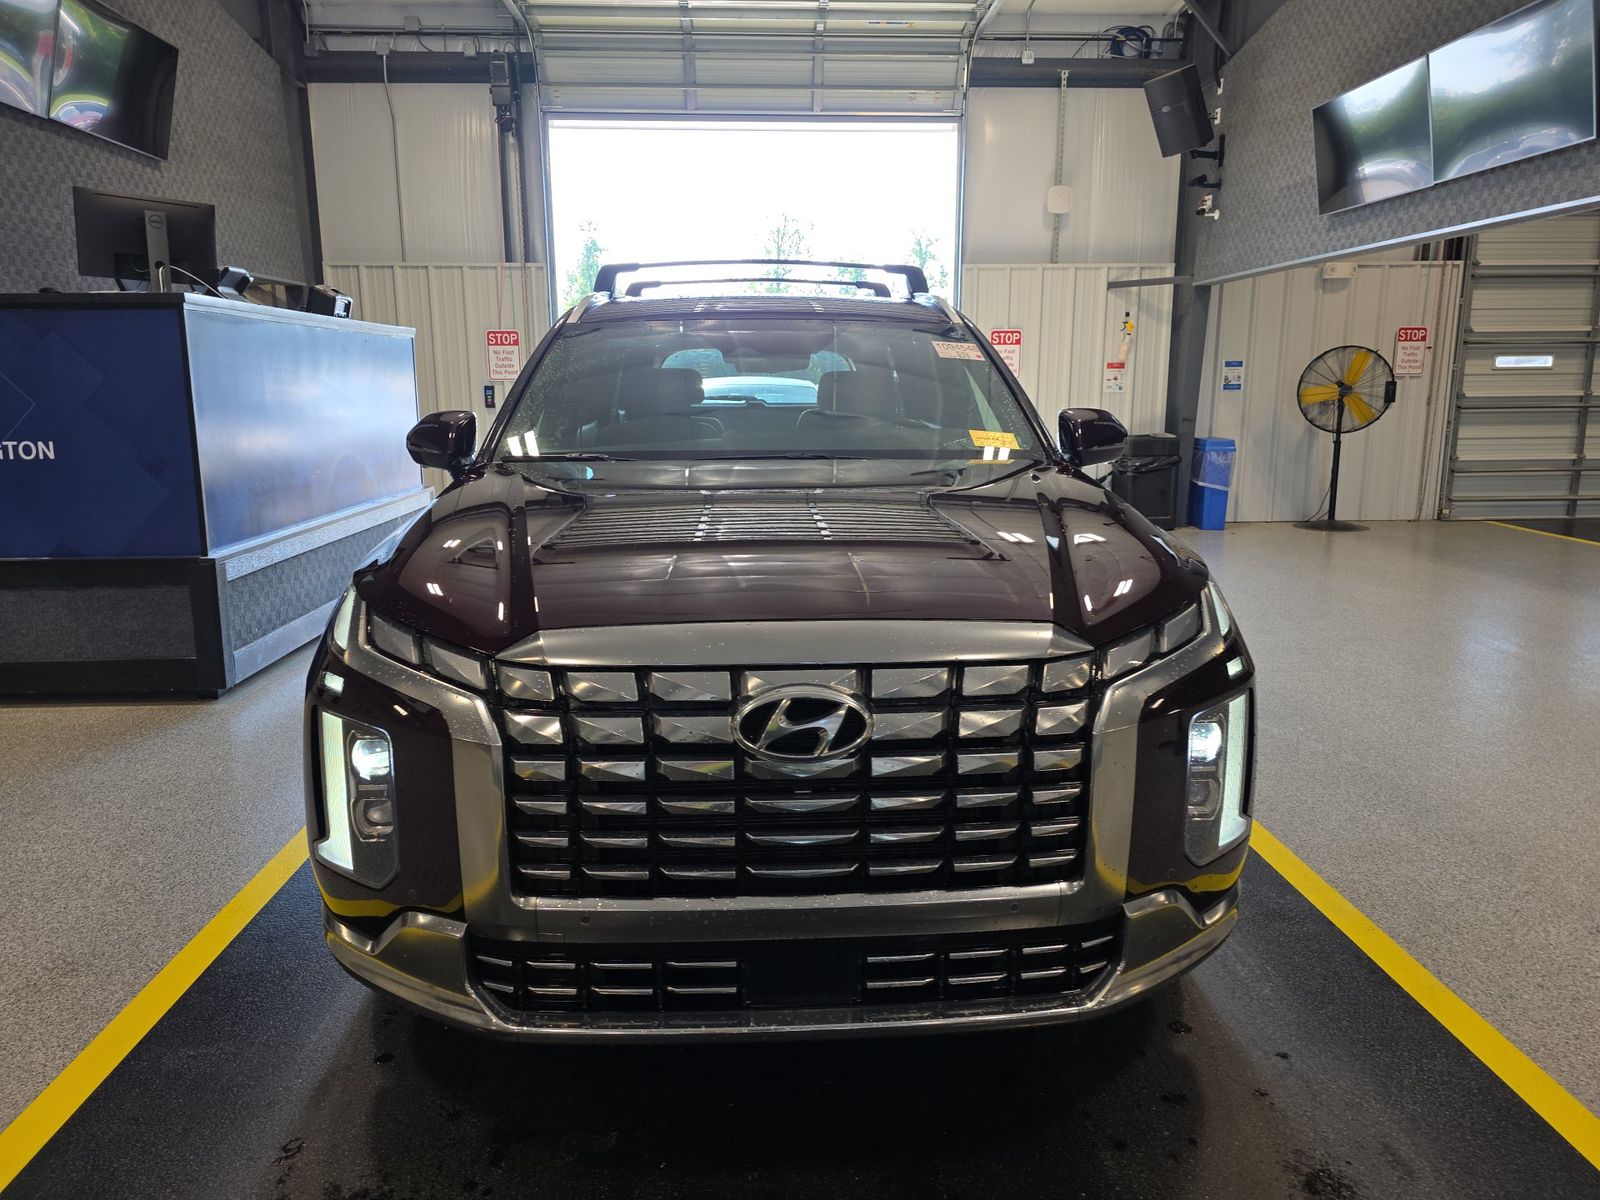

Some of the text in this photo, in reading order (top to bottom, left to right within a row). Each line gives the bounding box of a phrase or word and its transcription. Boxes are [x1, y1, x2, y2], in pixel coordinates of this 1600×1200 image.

[488, 333, 518, 345] STOP
[992, 332, 1021, 344] STOP
[1399, 329, 1426, 341] STOP
[0, 440, 55, 460] TON
